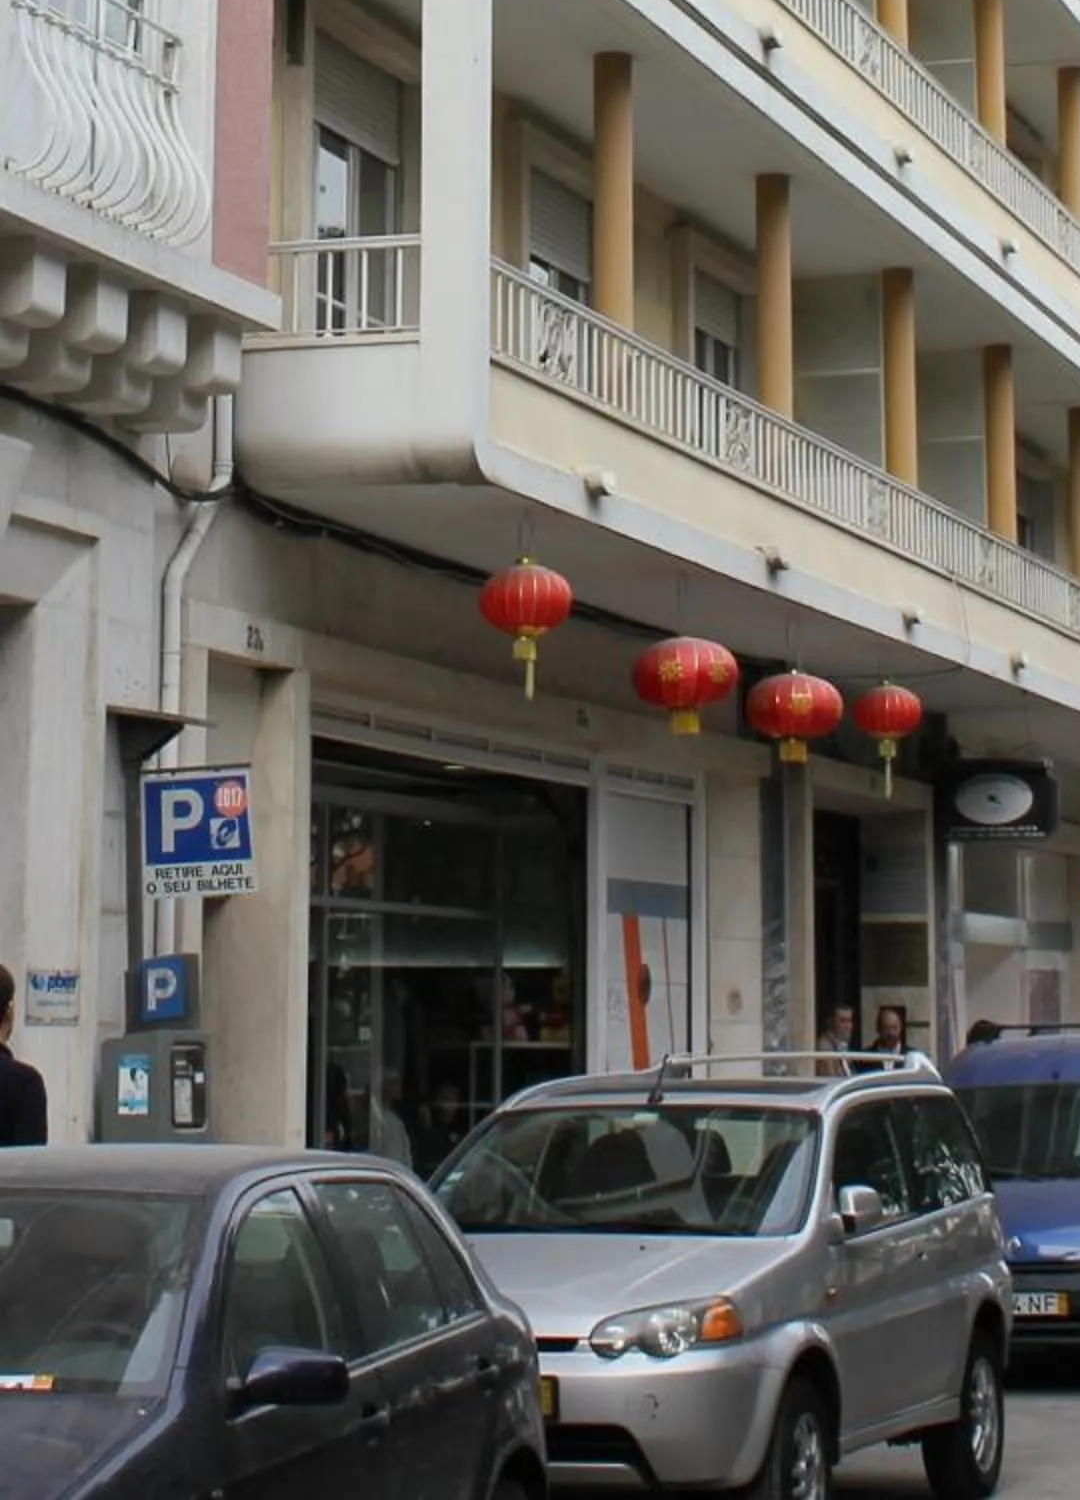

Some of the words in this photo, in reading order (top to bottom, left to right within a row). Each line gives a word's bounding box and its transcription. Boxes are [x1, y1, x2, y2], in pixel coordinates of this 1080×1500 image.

[161, 788, 204, 853] P
[146, 882, 157, 895] O
[163, 881, 191, 894] SEU
[197, 877, 254, 892] BILHETE
[155, 866, 204, 880] RETIRE
[211, 863, 244, 877] AQUI
[147, 966, 177, 1011] P
